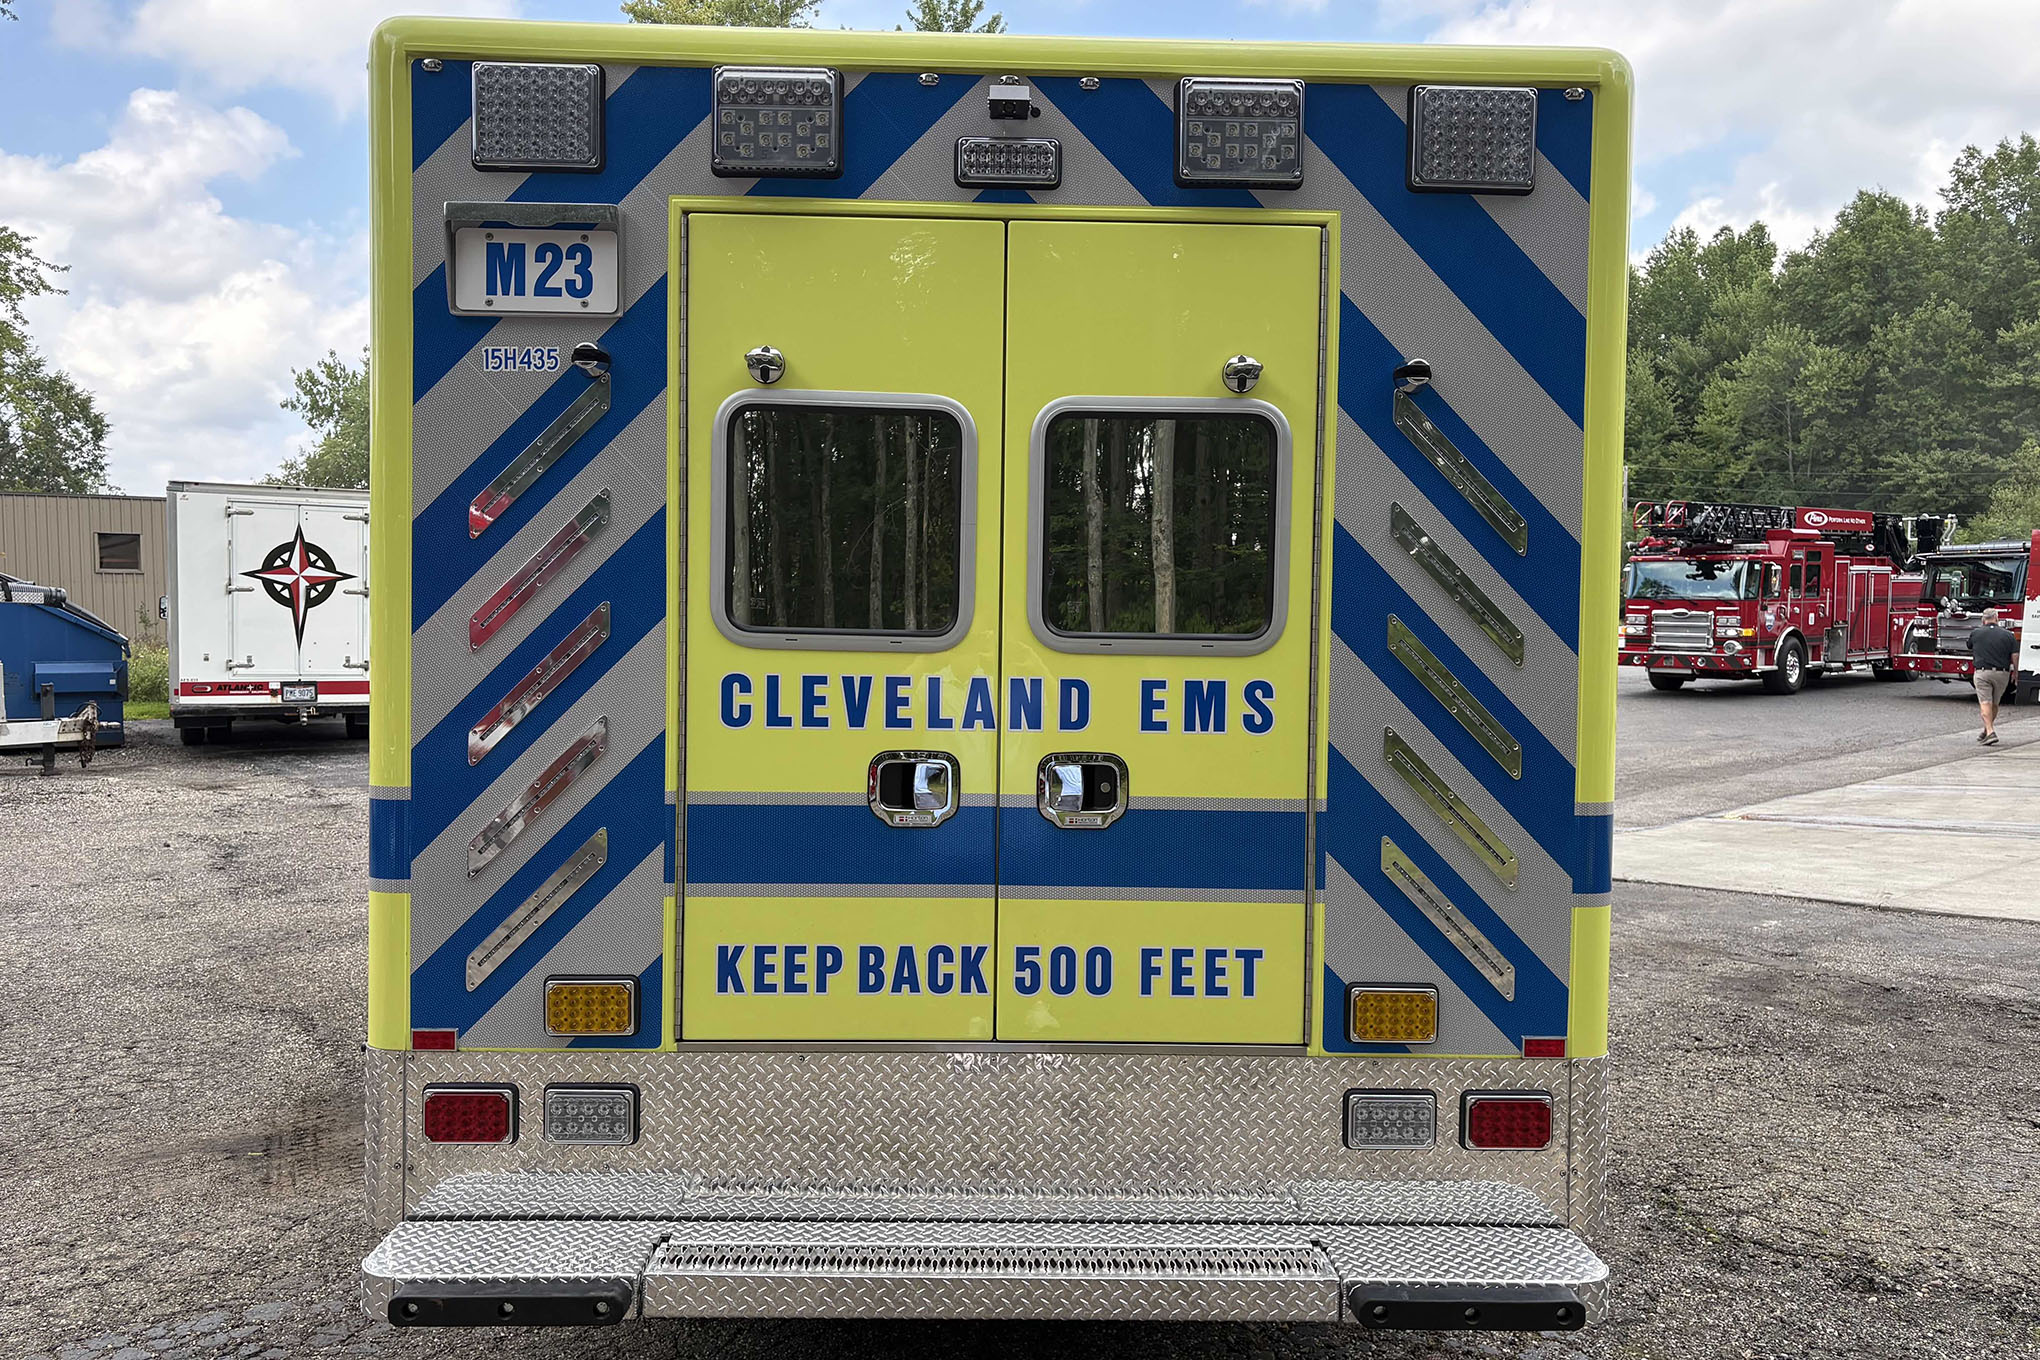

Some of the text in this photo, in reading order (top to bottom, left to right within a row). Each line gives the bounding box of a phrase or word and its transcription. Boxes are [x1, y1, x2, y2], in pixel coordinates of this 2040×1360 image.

[719, 672, 1276, 735] CLEVELAND EMS
[715, 943, 1265, 999] KEEP BACK 500 FEET
